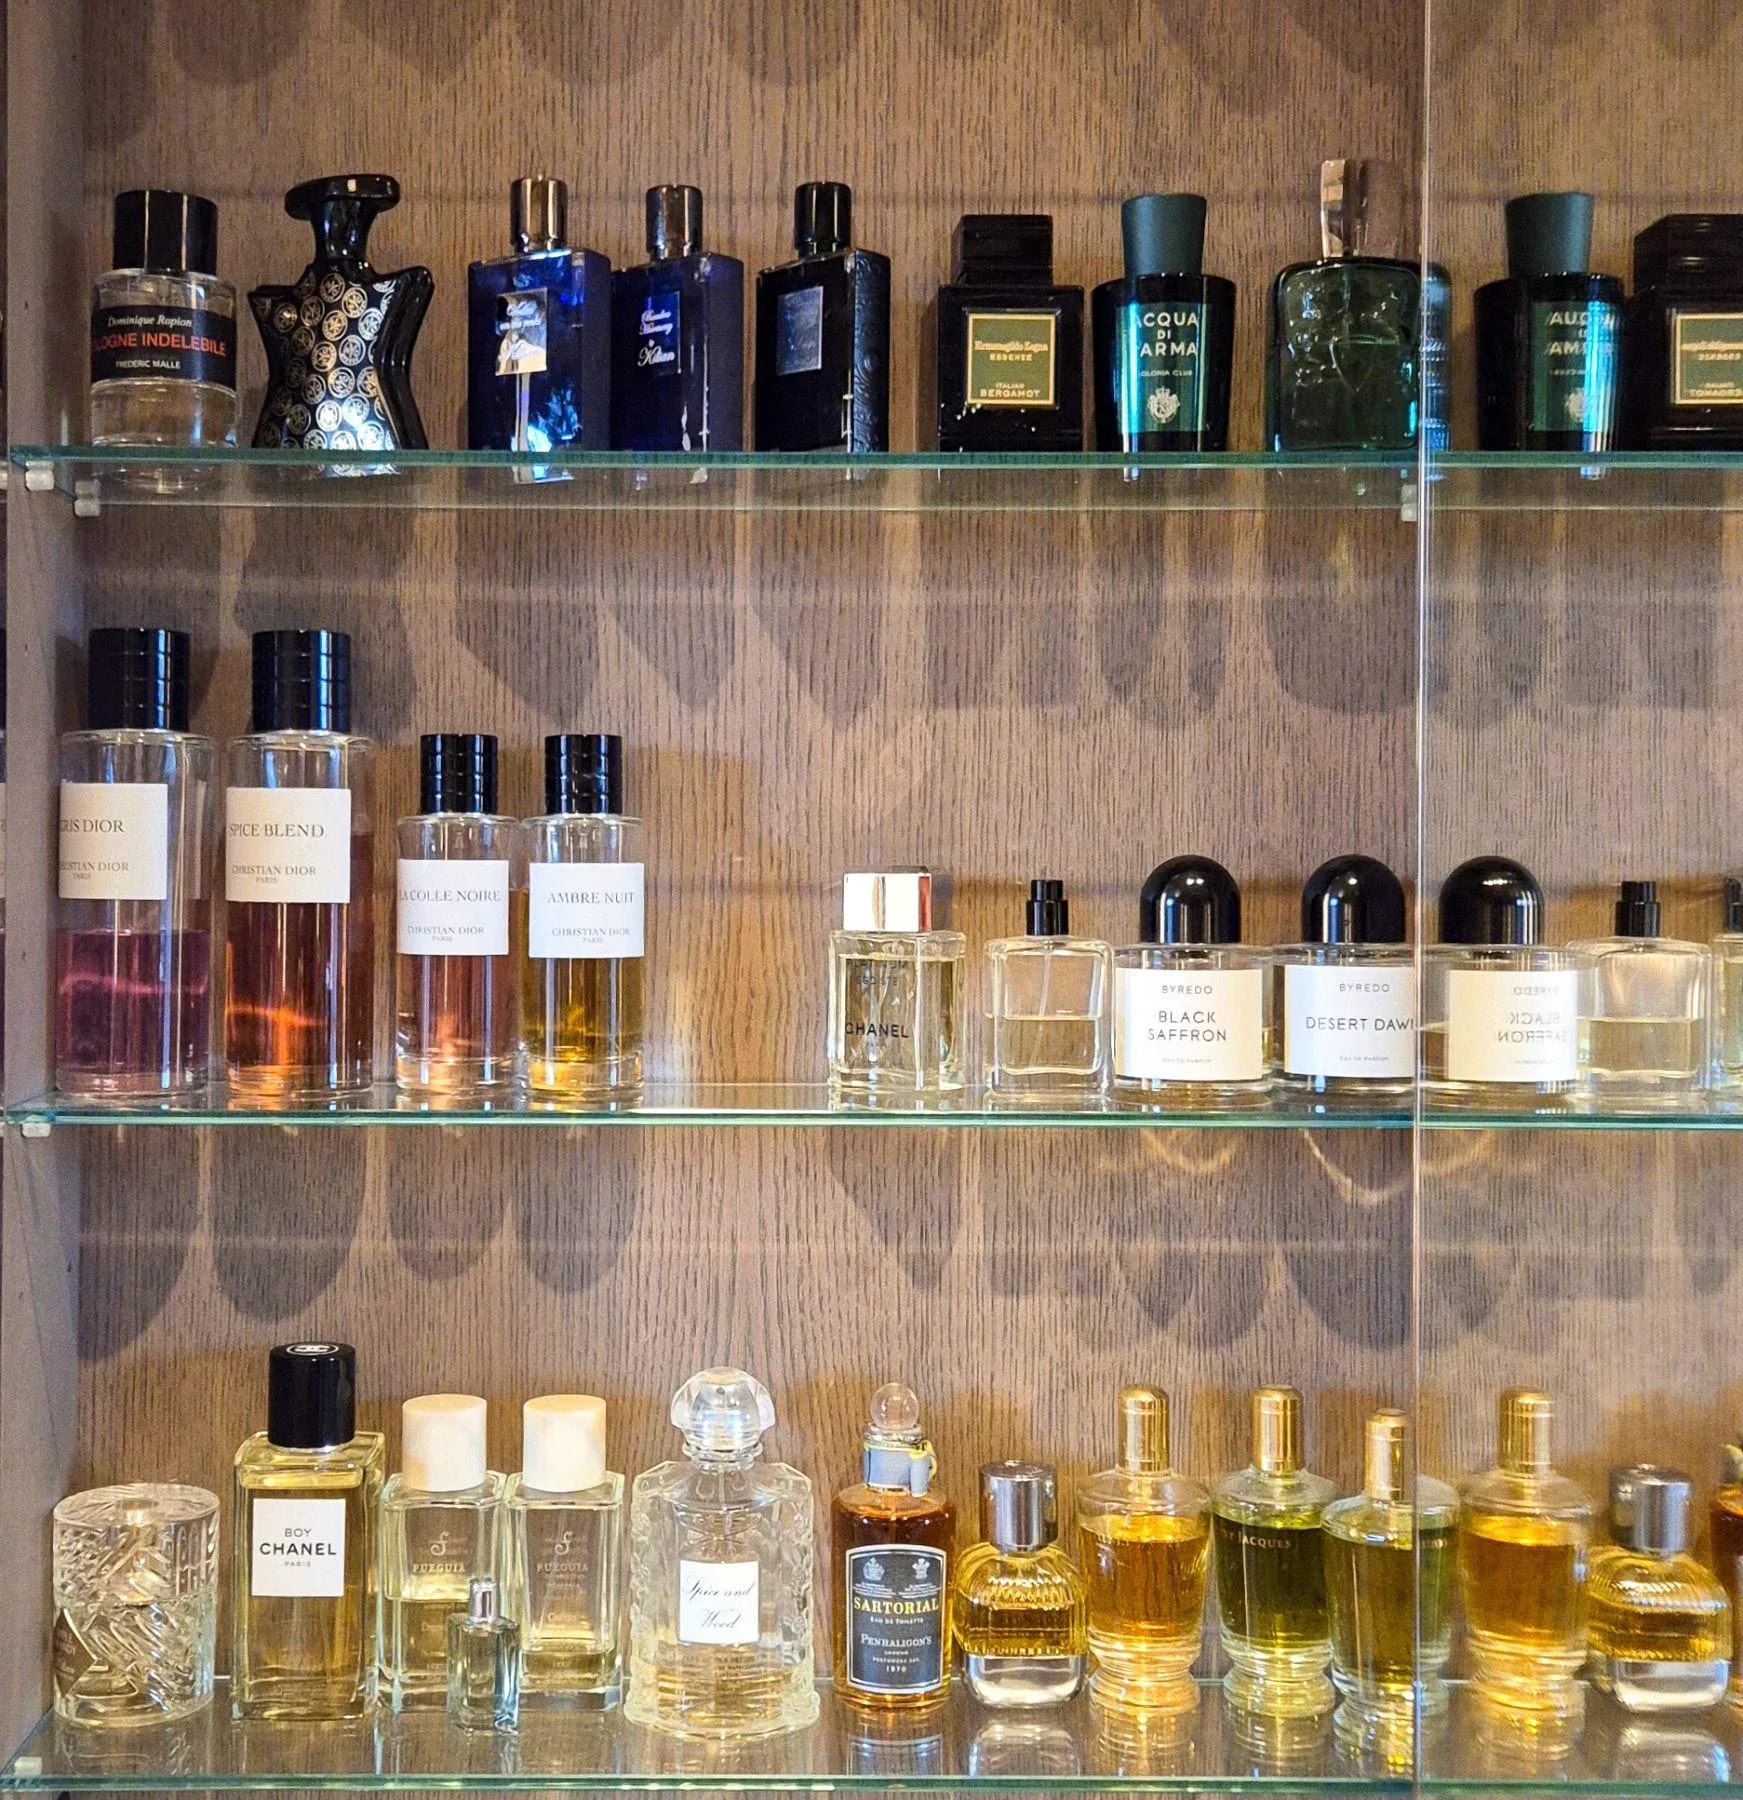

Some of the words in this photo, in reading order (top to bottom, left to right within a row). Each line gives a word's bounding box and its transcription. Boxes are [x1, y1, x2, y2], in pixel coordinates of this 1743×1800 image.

[108, 315, 154, 327] Dominique
[157, 314, 192, 328] Ropion
[1157, 329, 1171, 339] DI
[142, 333, 226, 357] INDELEBILE
[1137, 341, 1198, 357] ARMA
[152, 360, 181, 369] MALLE
[980, 389, 1040, 398] BERGAMOT
[83, 819, 125, 833] DIOR
[229, 823, 260, 837] SPICE
[264, 823, 324, 838] BLEND
[98, 862, 129, 871] DIOR
[231, 865, 282, 875] CHRISTIAN
[285, 866, 317, 875] DIOR
[256, 876, 278, 884] PARIS
[456, 890, 502, 902] NOIRE
[547, 891, 600, 904] AMBRE
[604, 891, 635, 904] NUIT
[407, 925, 456, 935] CHRISTIAN
[458, 926, 485, 935] DIOR
[551, 927, 606, 937] CHRISTIAN
[608, 927, 632, 936] DIOR
[1162, 985, 1213, 995] BYREDO
[1339, 983, 1390, 993] BYREDO
[1158, 1010, 1216, 1024] BLACK
[1306, 1016, 1368, 1031] DESERT
[845, 1022, 909, 1038] CHANEL
[1148, 1028, 1227, 1042] SAFFRON
[284, 1527, 313, 1538] BOY
[260, 1542, 337, 1556] CHANEL
[412, 1563, 466, 1573] FUEGUIA
[724, 1582, 756, 1597] and
[854, 1597, 939, 1614] SARTORIAL
[861, 1632, 932, 1647] PENHALIGON'S
